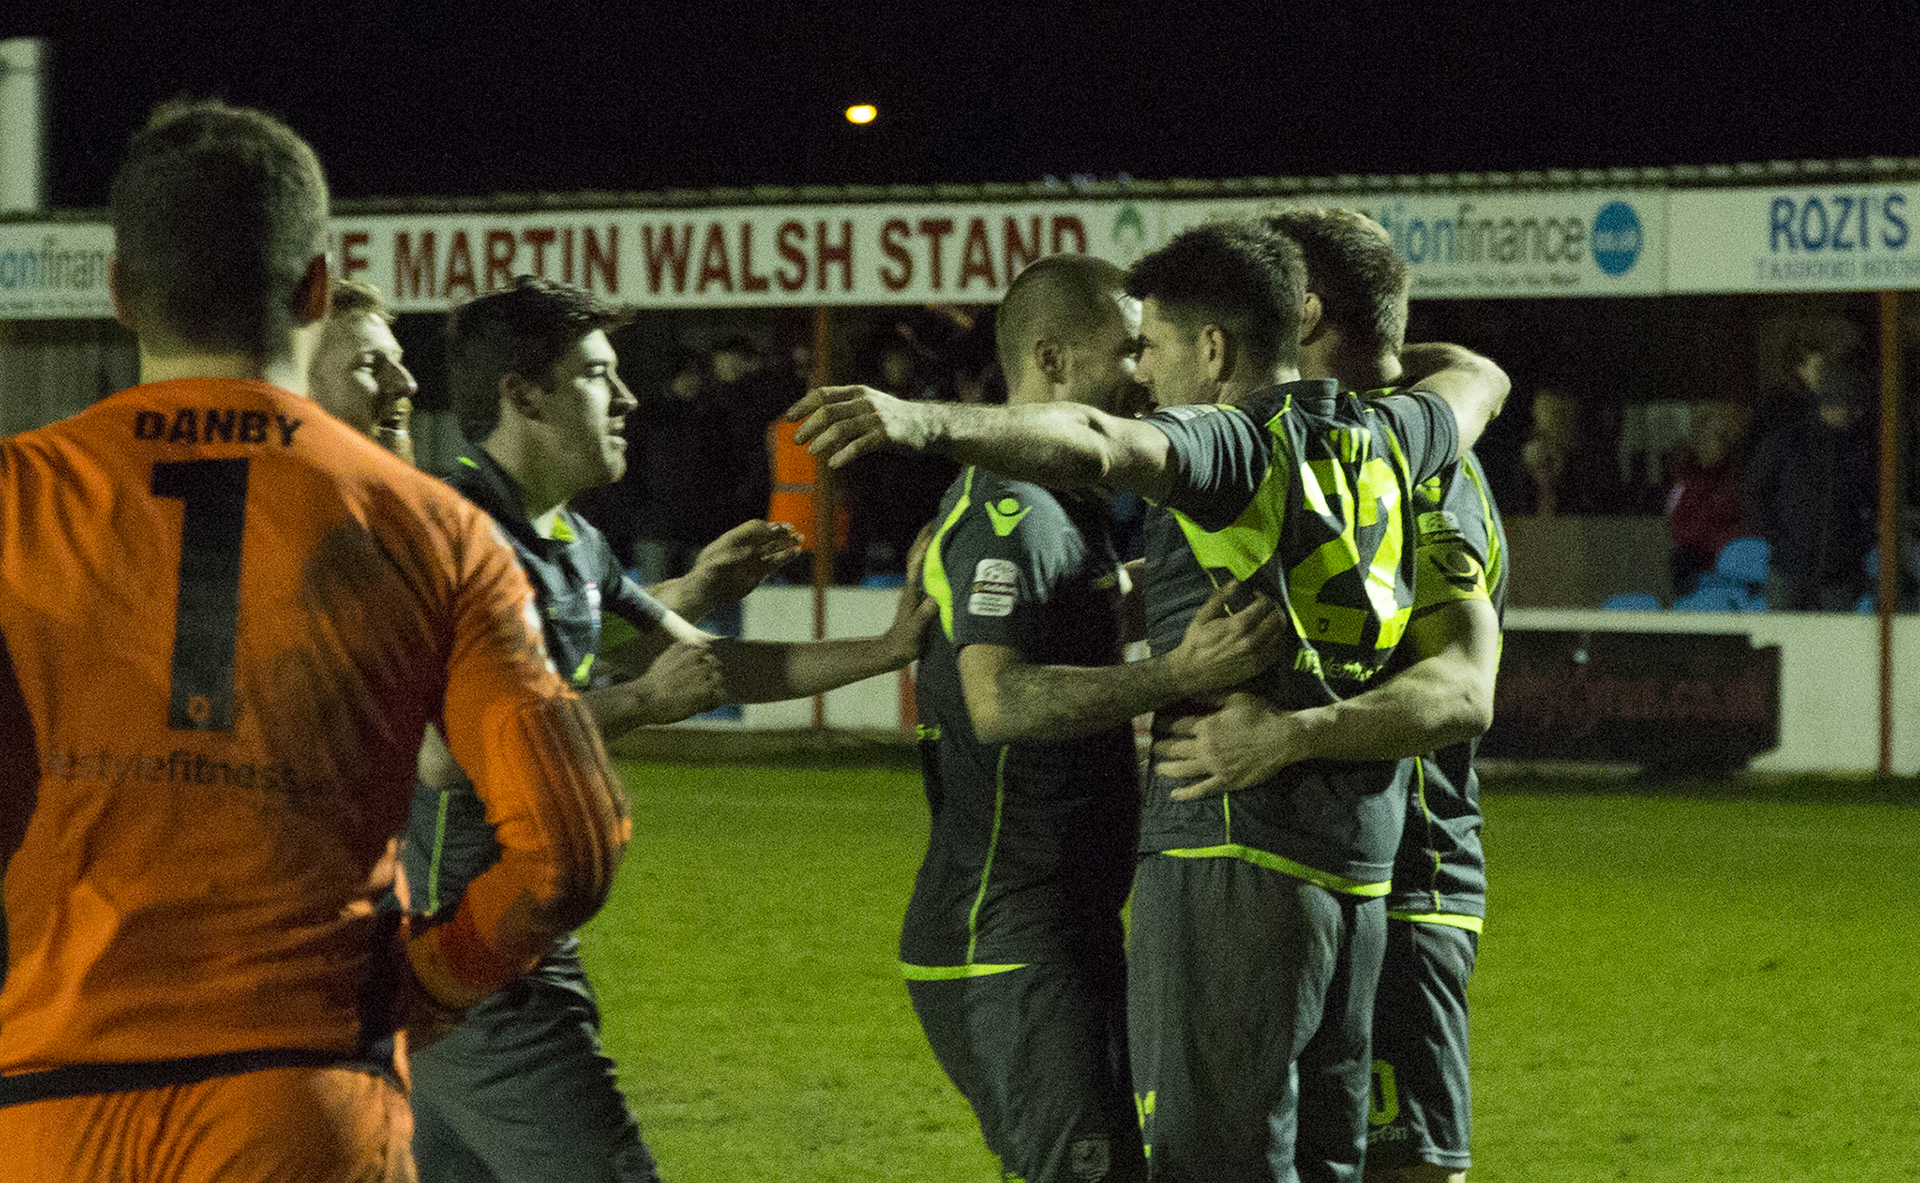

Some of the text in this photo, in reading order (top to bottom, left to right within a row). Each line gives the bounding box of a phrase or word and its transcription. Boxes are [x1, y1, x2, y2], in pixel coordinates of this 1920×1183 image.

[394, 225, 620, 299] MARTIN
[642, 220, 853, 296] WALSH
[133, 407, 303, 447] DANBY
[150, 456, 249, 731] 1
